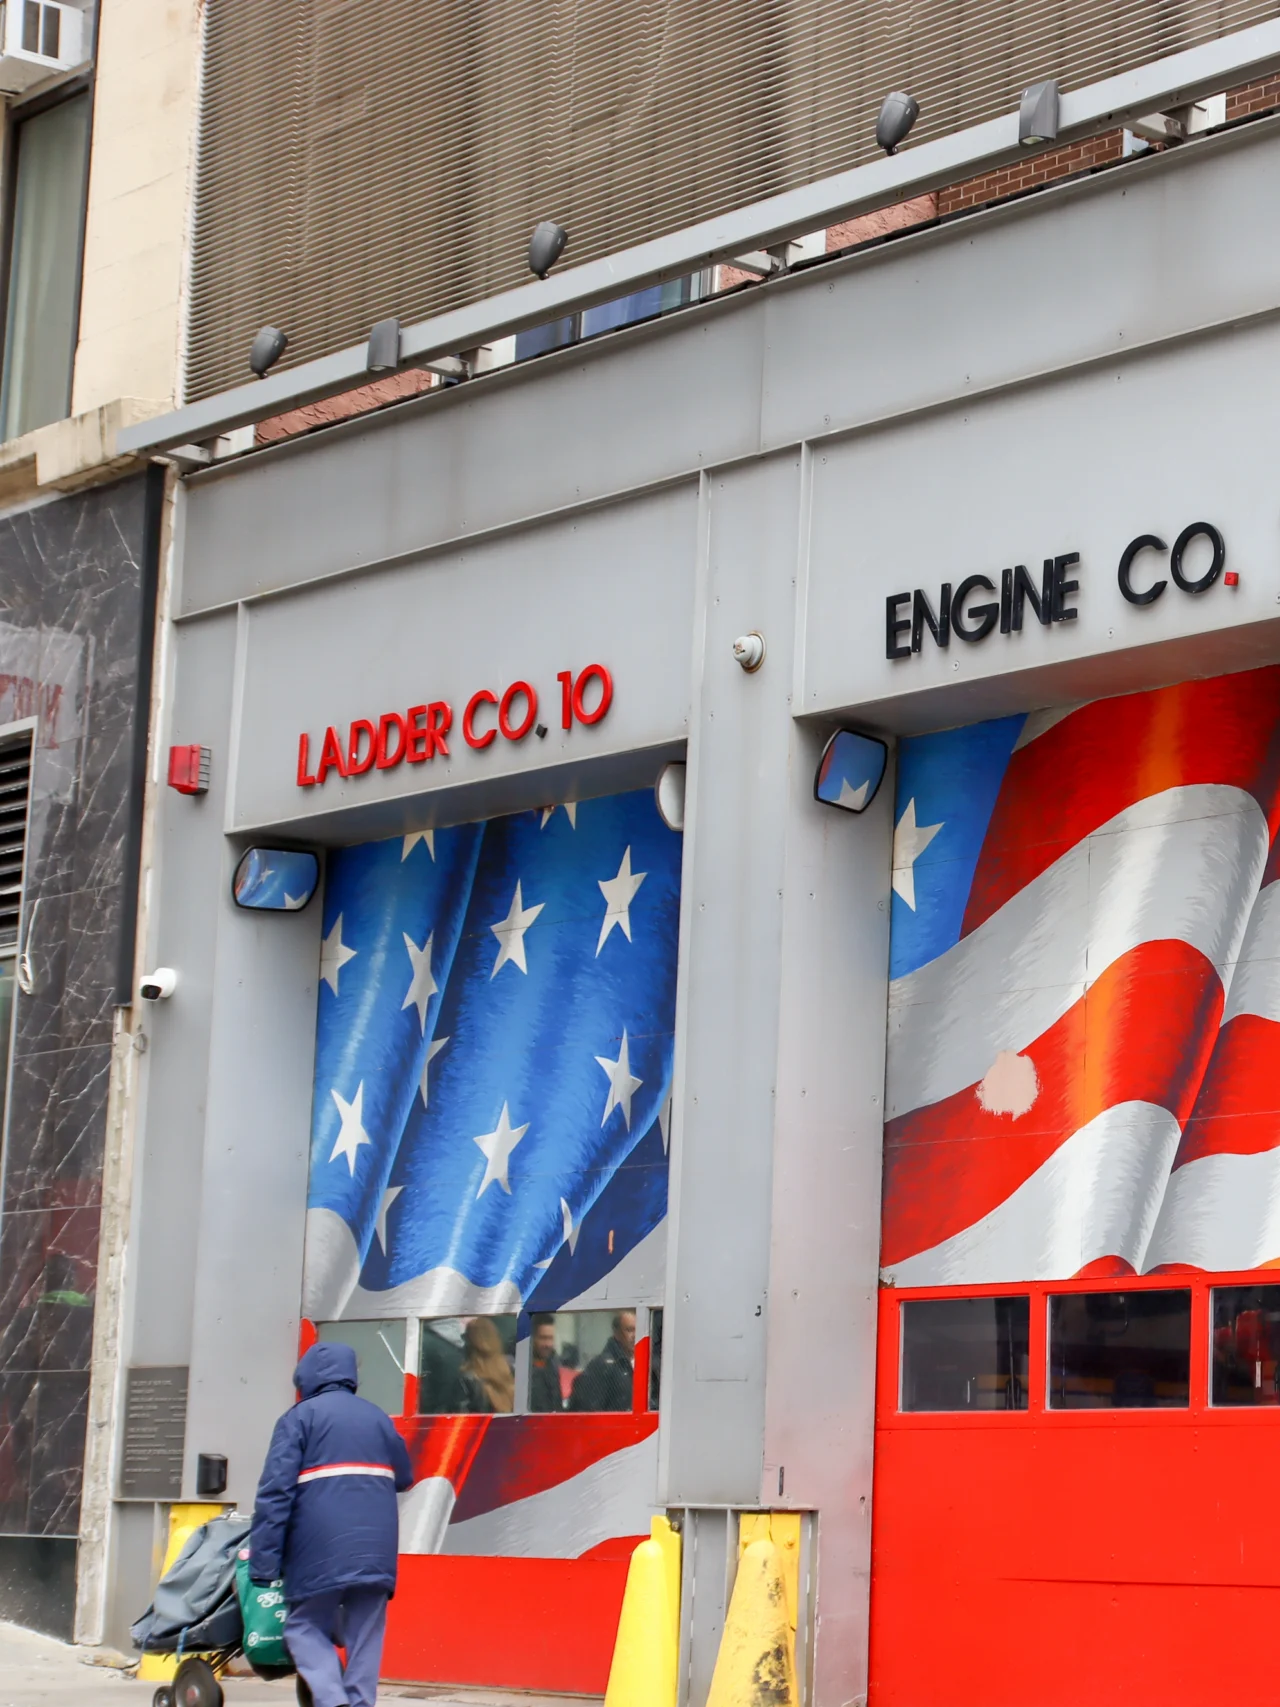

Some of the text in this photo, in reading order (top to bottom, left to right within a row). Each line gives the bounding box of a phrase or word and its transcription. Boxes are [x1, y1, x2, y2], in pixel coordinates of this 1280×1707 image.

[886, 552, 1080, 660] ENGINE
[1118, 521, 1239, 606] CO.
[297, 664, 613, 786] LADDER CO. 10
